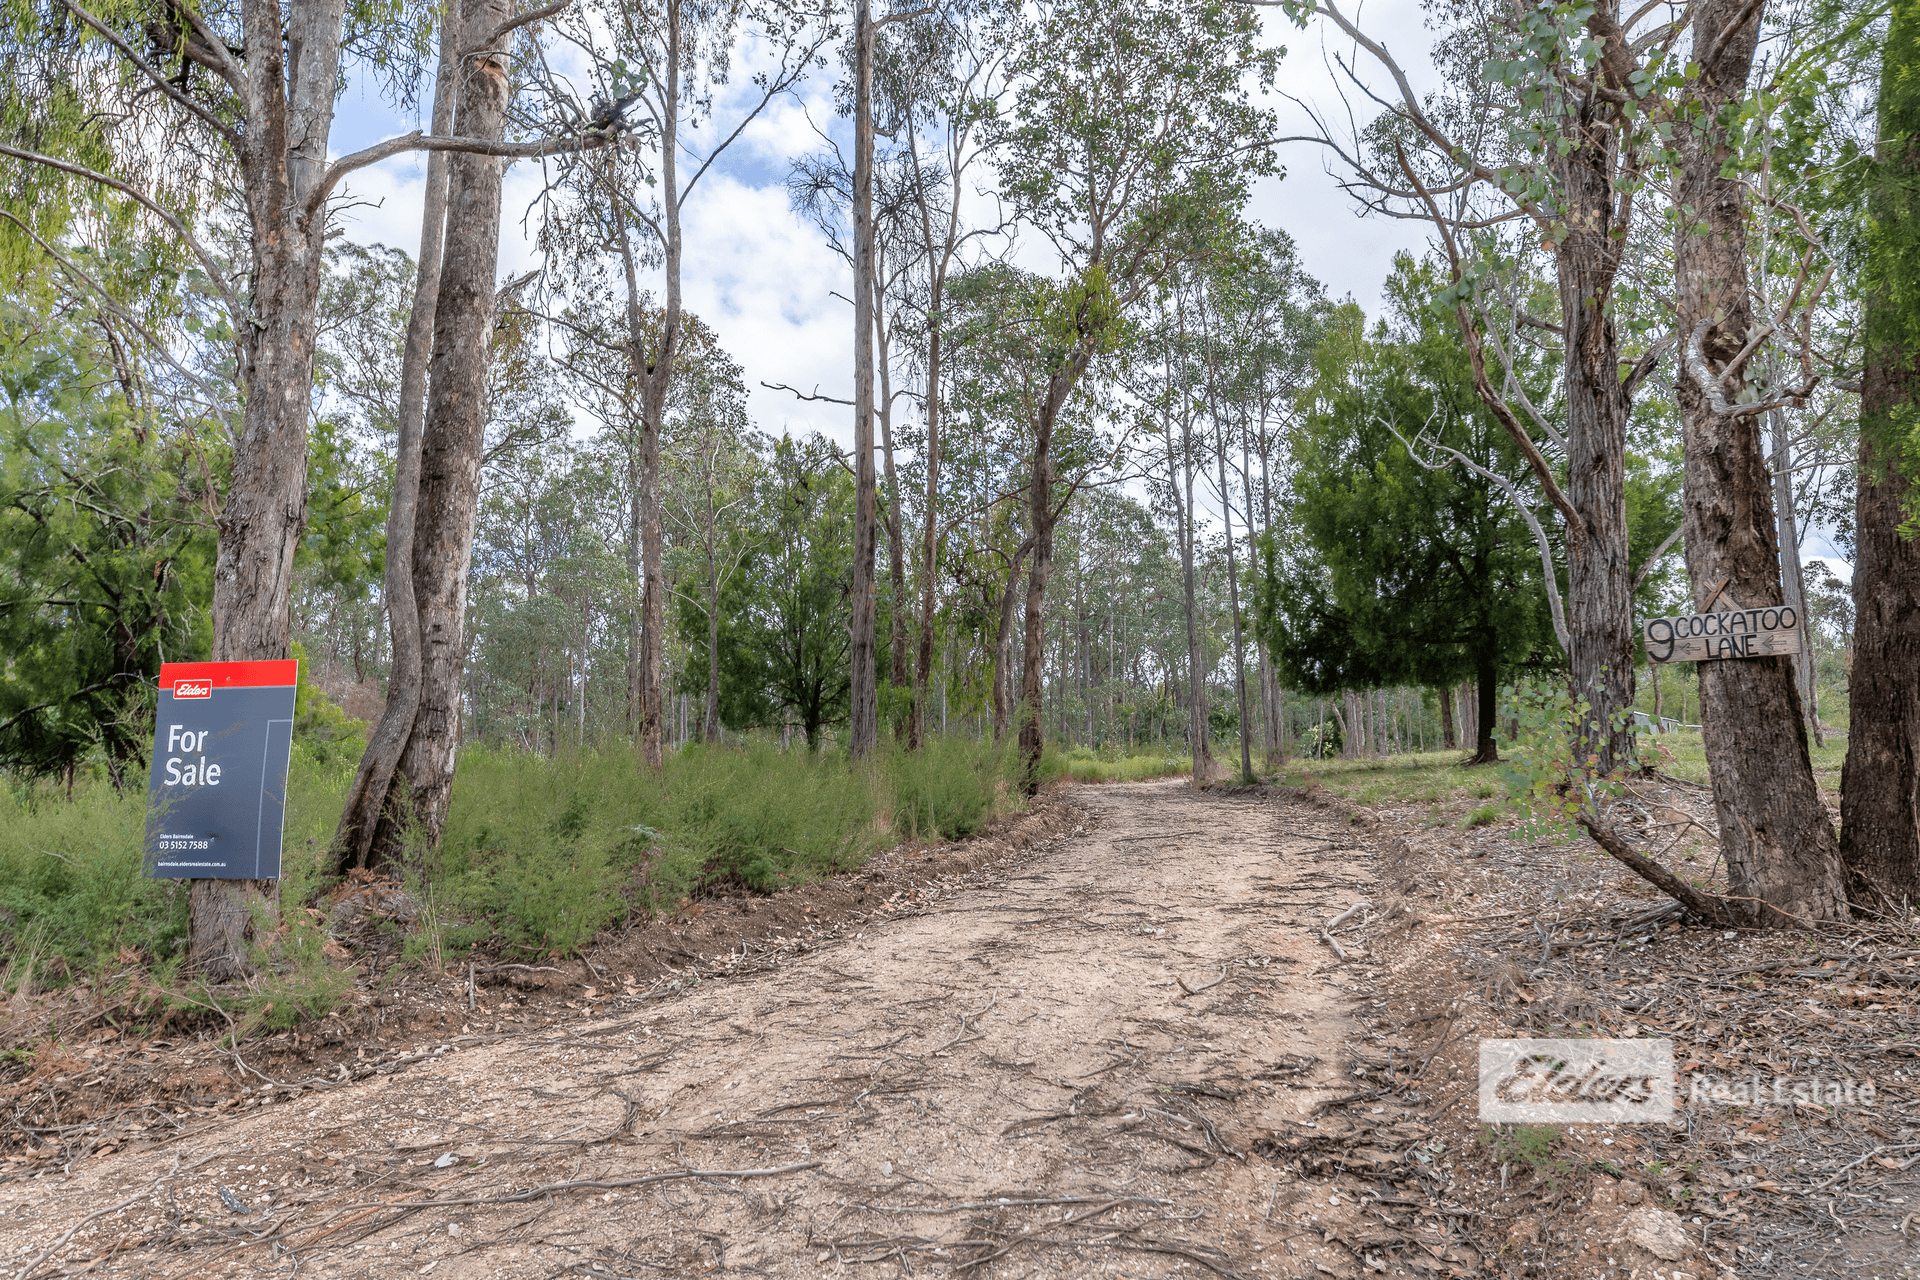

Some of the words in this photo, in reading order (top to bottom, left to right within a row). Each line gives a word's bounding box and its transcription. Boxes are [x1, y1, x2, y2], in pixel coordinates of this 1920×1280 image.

[1648, 619, 1675, 662] 9
[1675, 607, 1797, 638] COCKATOO
[1705, 634, 1759, 659] LANE
[176, 683, 209, 696] Elders
[168, 724, 208, 752] For
[164, 756, 221, 786] Sale
[159, 840, 169, 850] 03
[170, 840, 188, 850] 5152
[189, 840, 209, 850] 7588
